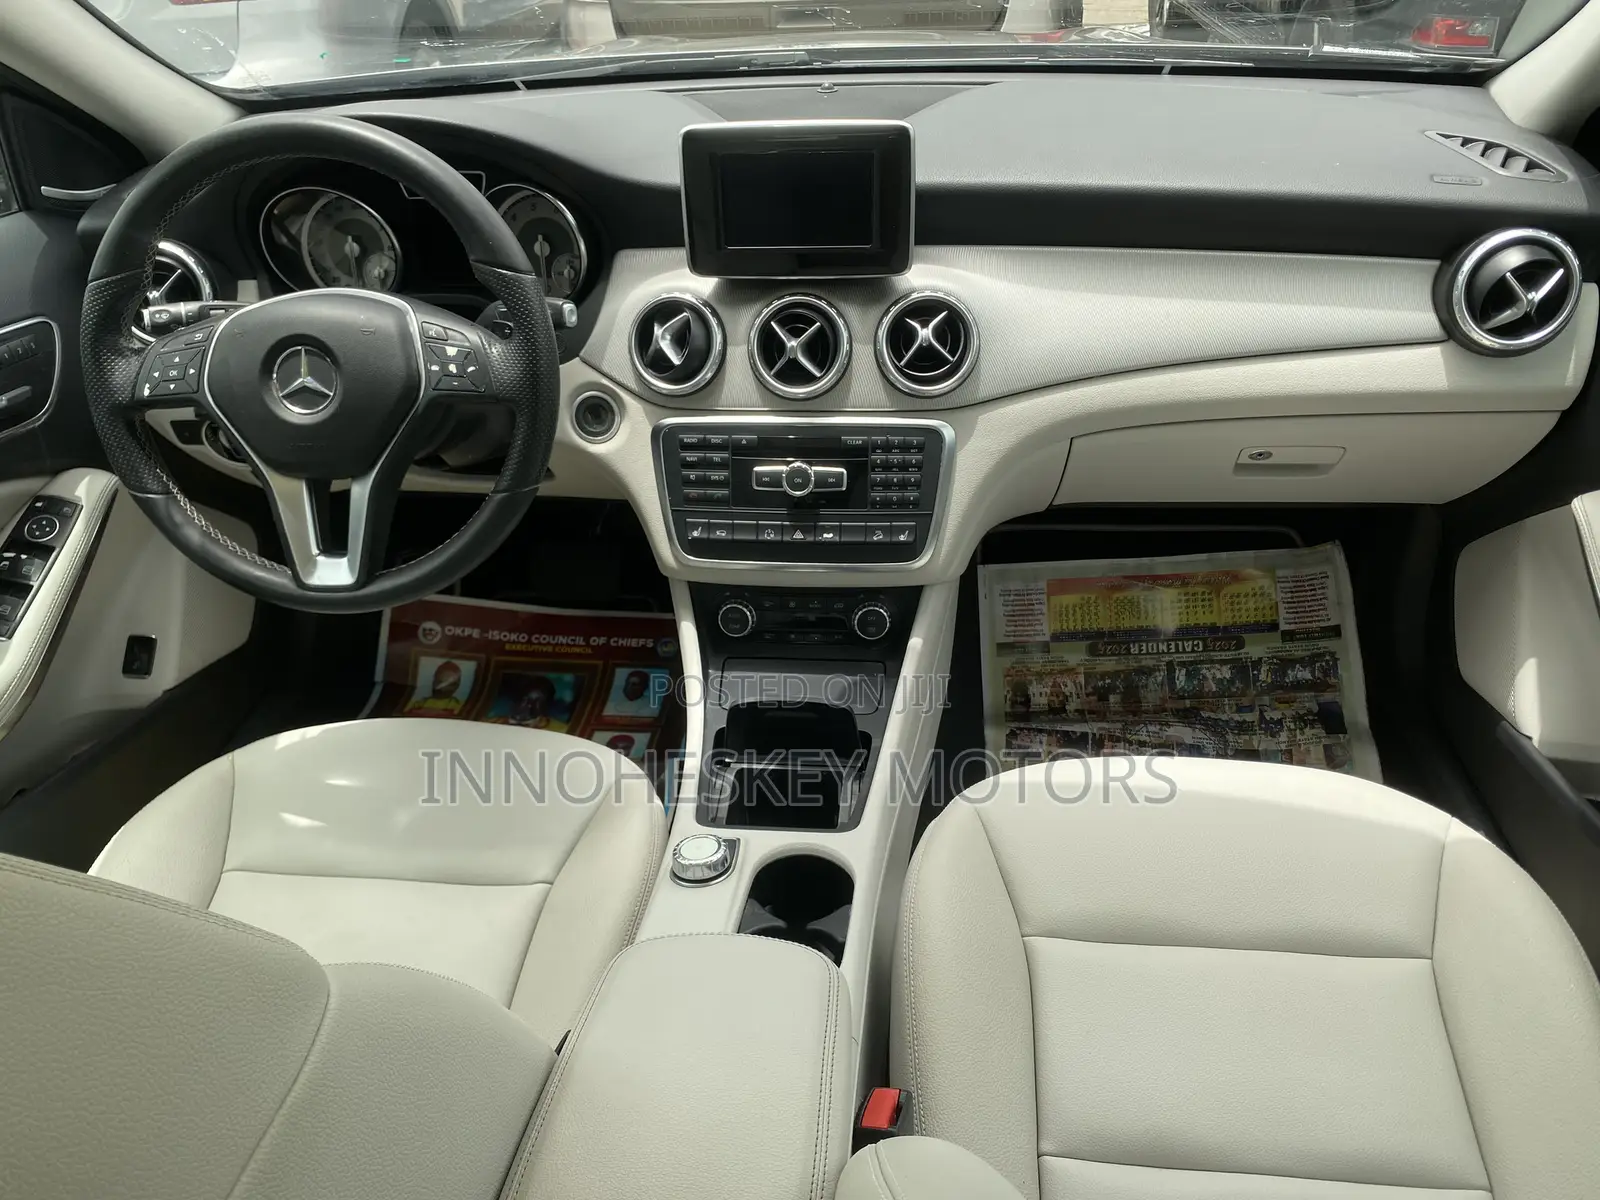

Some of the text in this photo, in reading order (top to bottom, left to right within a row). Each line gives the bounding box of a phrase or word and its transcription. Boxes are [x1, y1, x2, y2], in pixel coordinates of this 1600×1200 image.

[444, 625, 480, 639] OKPE
[530, 634, 586, 646] COUNCIL
[589, 636, 607, 646] OF
[610, 636, 654, 648] CHIEFS
[504, 643, 593, 654] EXECUTIVE COUNCIL
[1129, 640, 1204, 655] CALENDER
[1206, 639, 1237, 651] 2025
